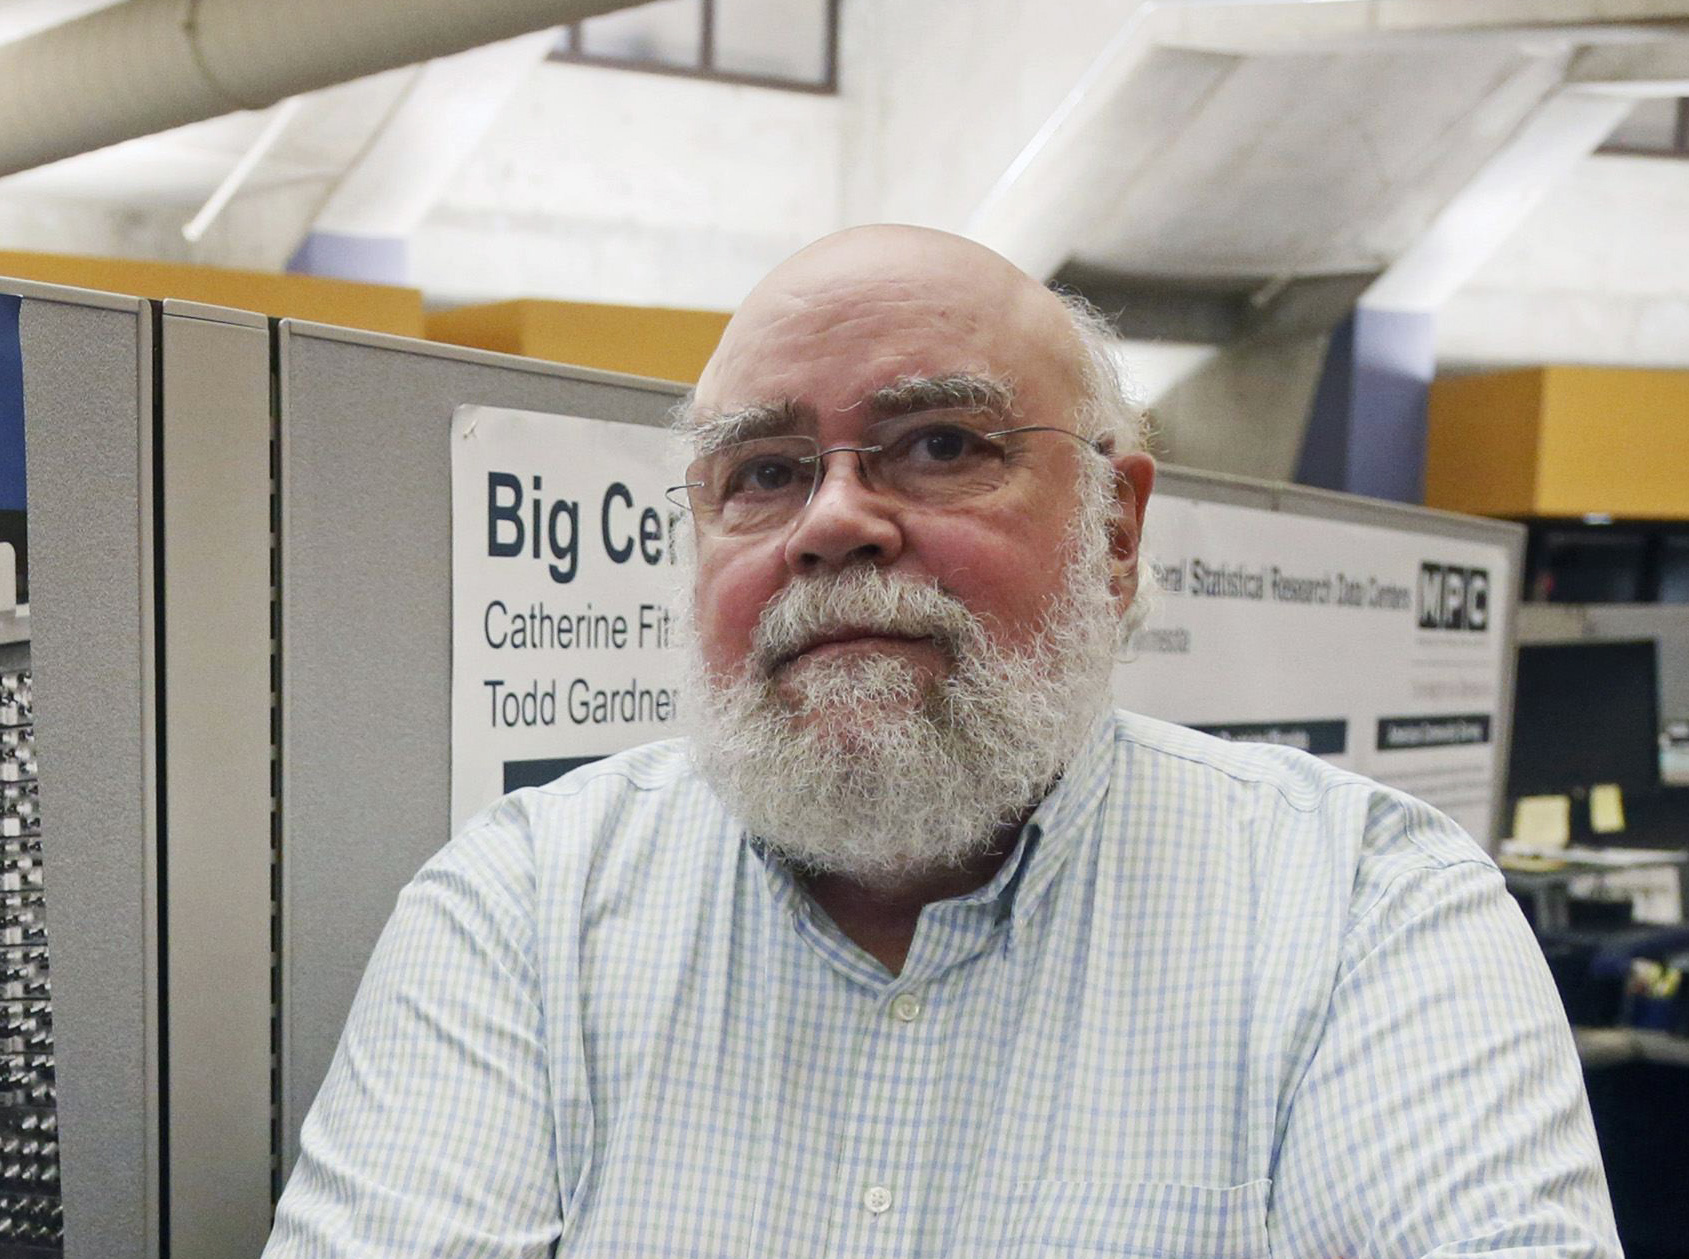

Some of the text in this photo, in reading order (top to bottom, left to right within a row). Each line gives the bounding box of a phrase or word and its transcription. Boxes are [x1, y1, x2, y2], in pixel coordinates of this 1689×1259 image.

[487, 471, 580, 584] Big
[484, 600, 684, 650] Catherine Fit
[484, 678, 678, 727] Todd Gardner
